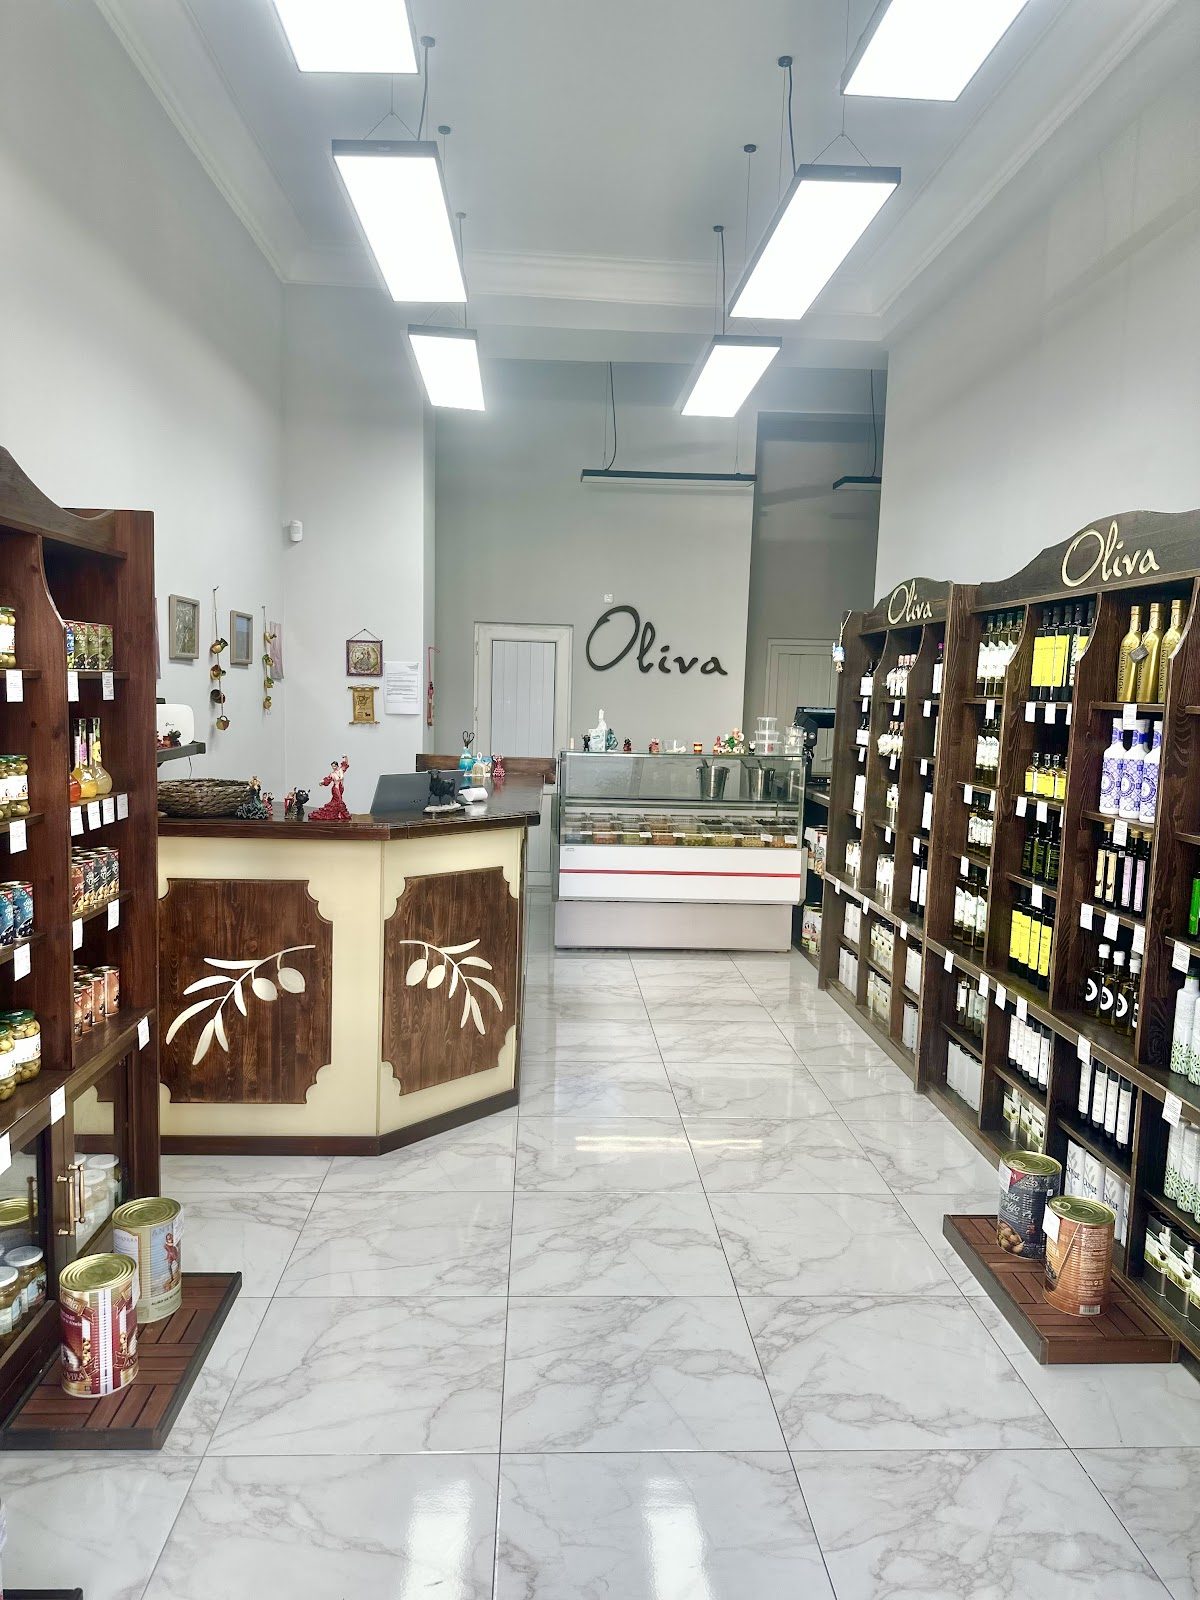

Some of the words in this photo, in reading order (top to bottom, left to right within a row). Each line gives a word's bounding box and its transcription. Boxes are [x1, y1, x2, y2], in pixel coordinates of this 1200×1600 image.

[1060, 519, 1160, 588] Oliva
[887, 578, 933, 625] Oliva
[586, 605, 728, 675] Oliva
[1118, 651, 1127, 692] SUMMUM
